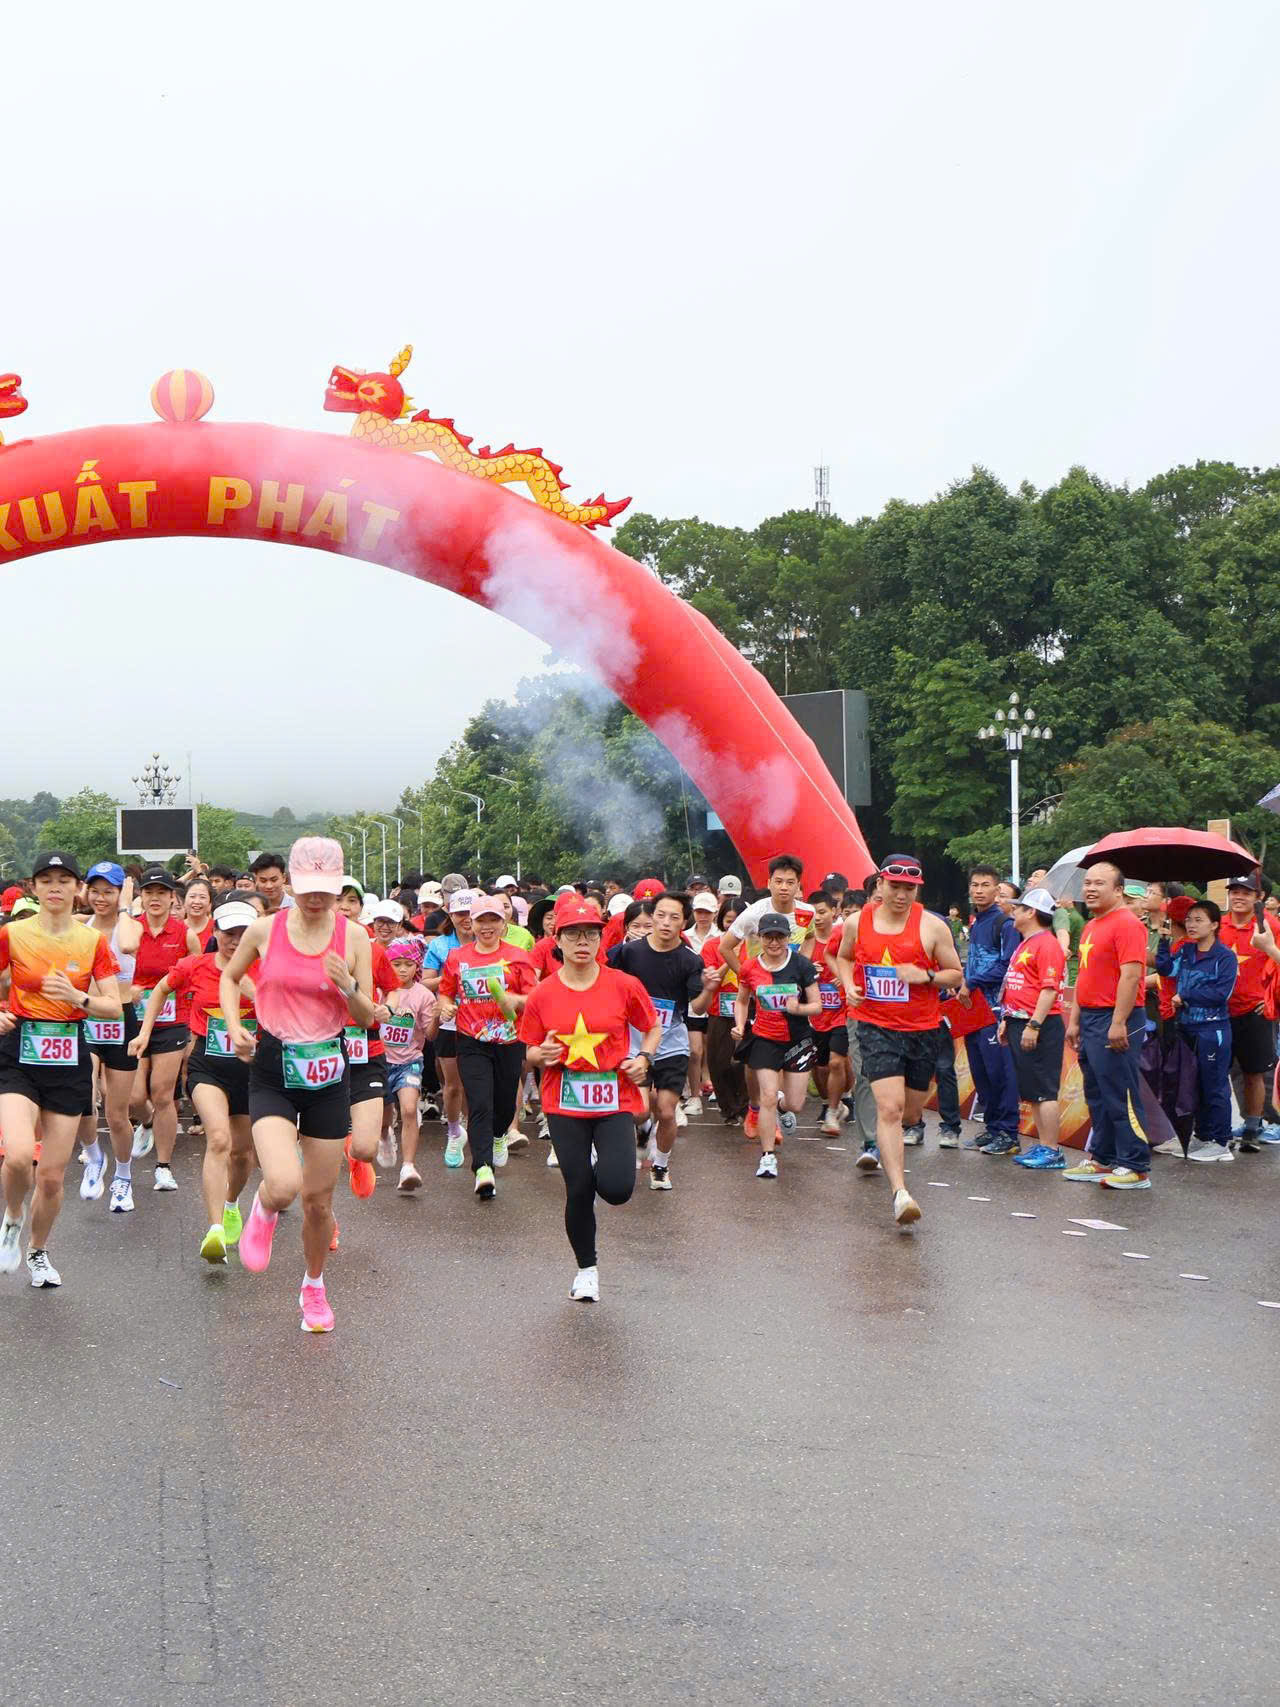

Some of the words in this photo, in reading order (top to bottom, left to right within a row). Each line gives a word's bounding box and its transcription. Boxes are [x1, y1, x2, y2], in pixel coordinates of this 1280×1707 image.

[207, 476, 401, 550] PHÁT
[877, 979, 904, 997] 1012
[95, 1023, 120, 1040] 155
[208, 1033, 215, 1042] 3
[384, 1026, 409, 1043] 365
[23, 1040, 31, 1050] 3
[41, 1037, 73, 1059] 258
[286, 1064, 294, 1075] 3
[306, 1057, 338, 1083] 457
[581, 1083, 614, 1105] 183
